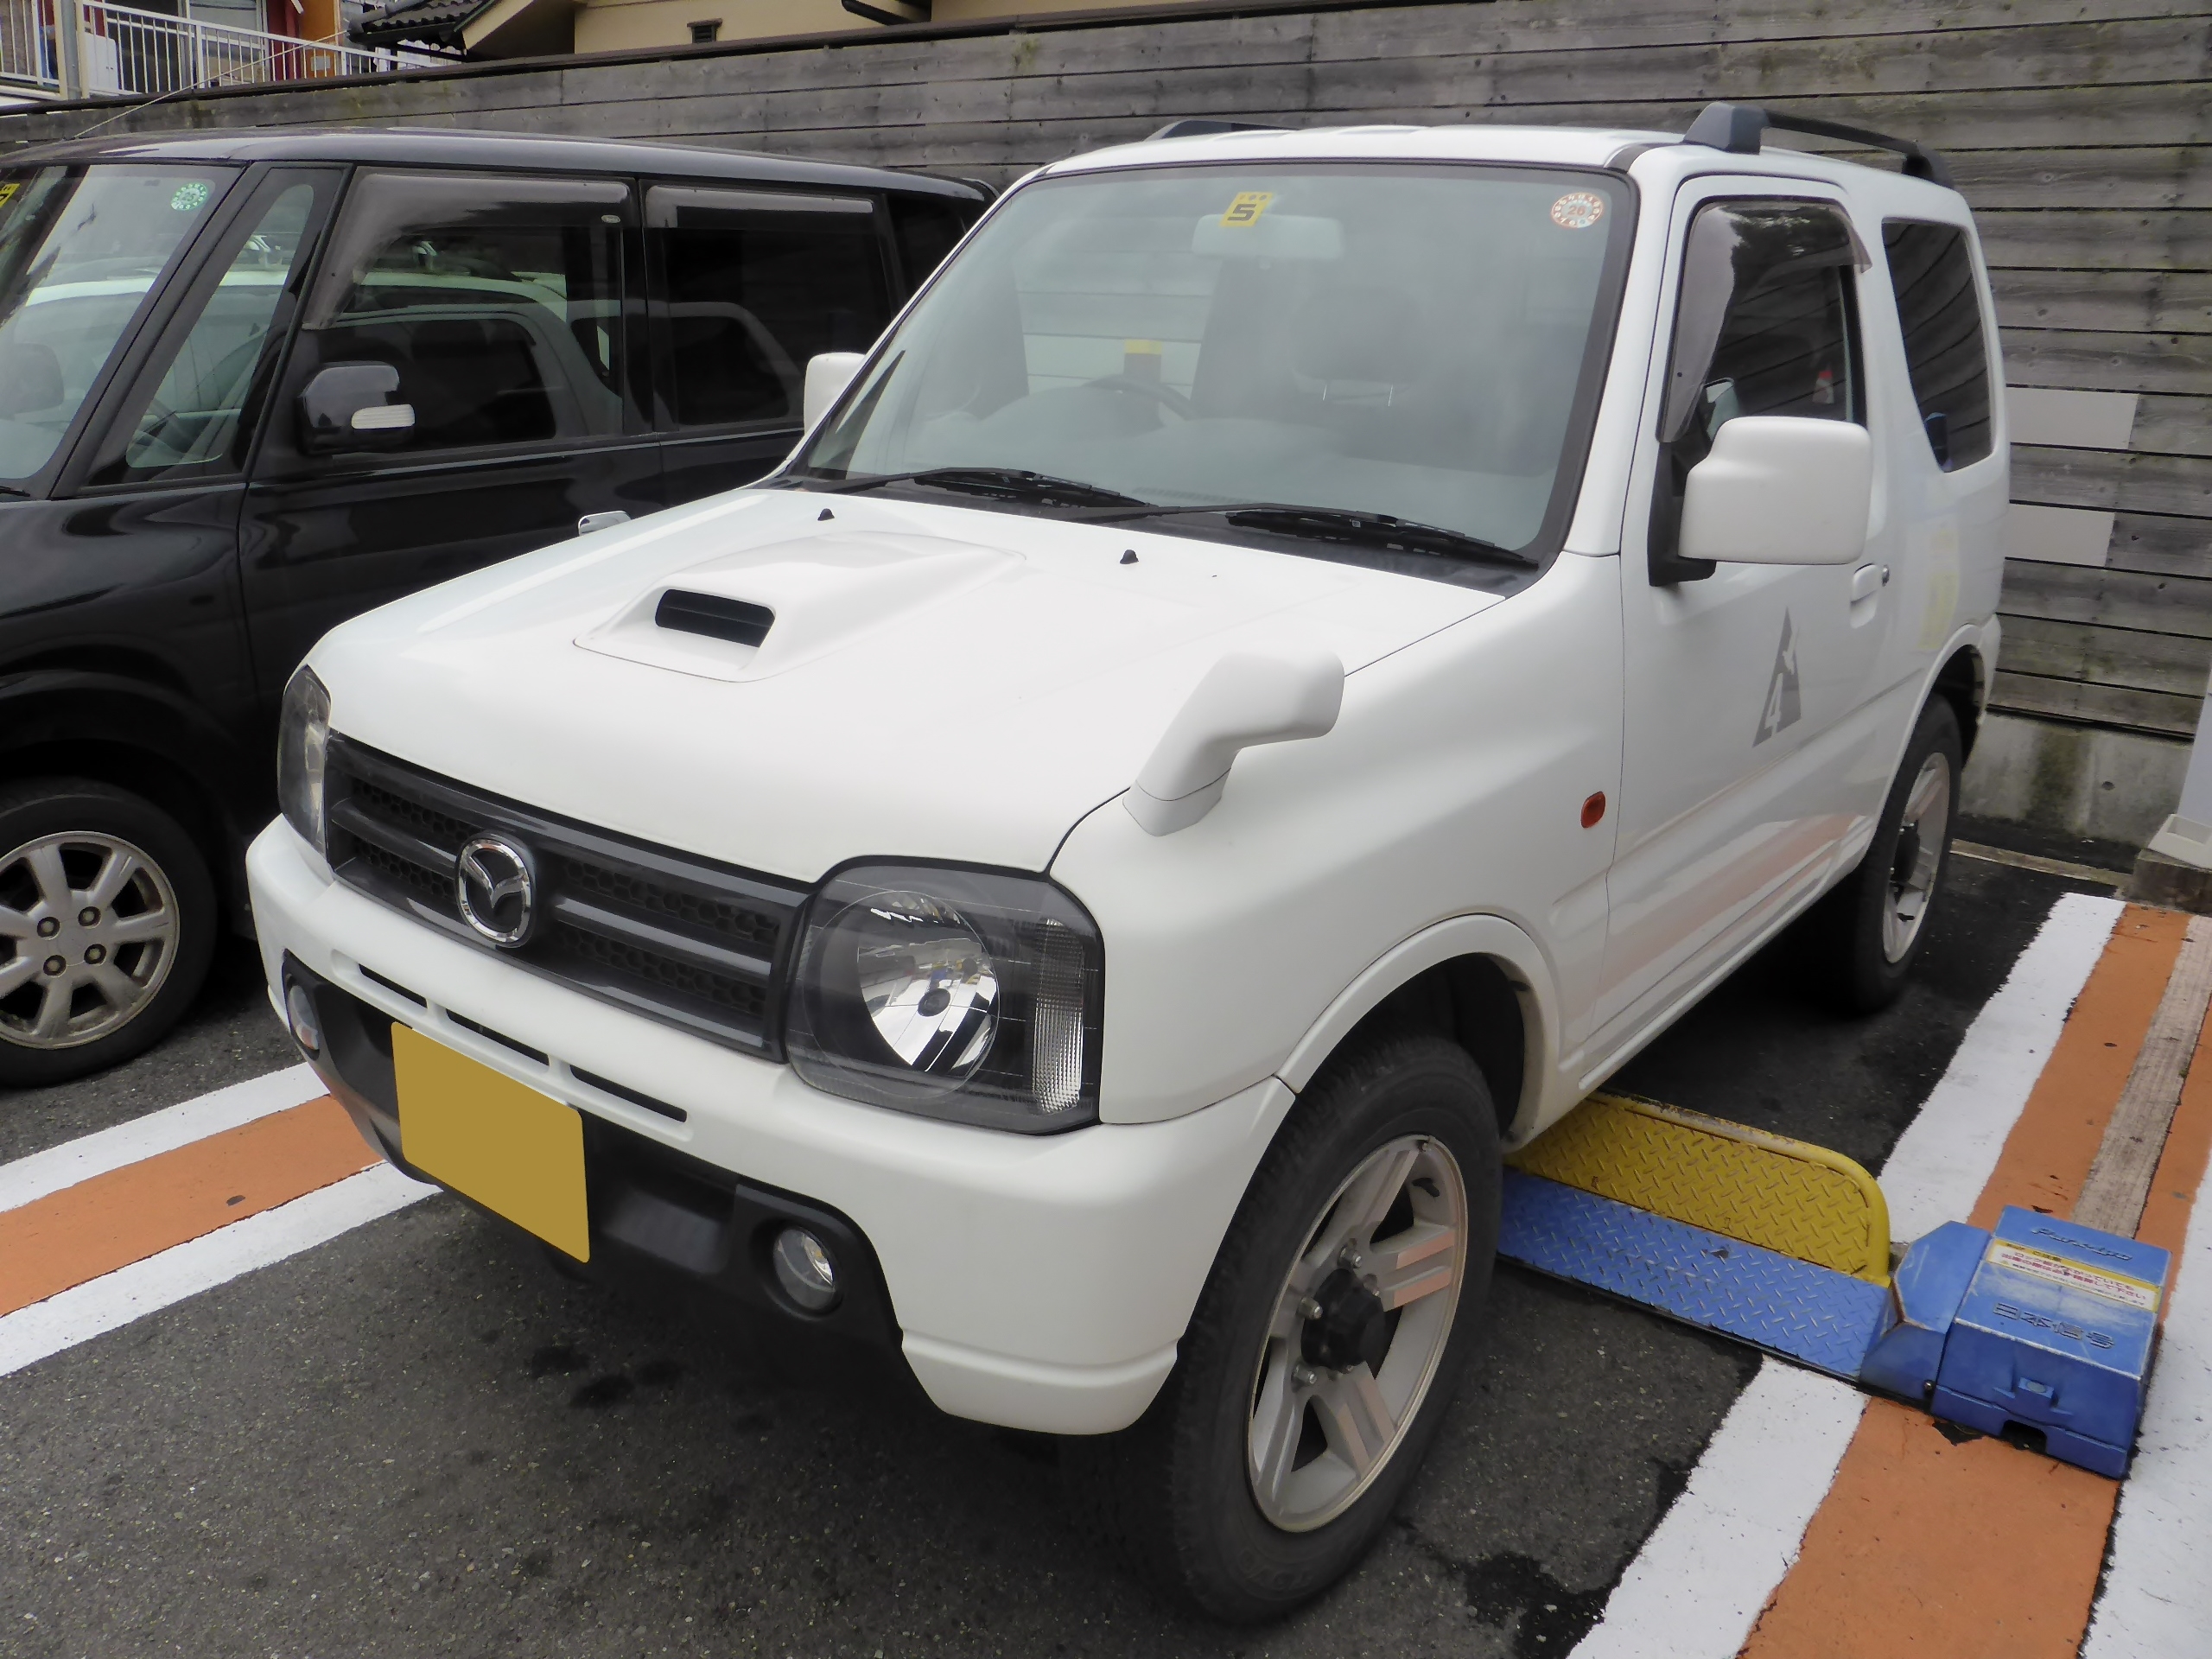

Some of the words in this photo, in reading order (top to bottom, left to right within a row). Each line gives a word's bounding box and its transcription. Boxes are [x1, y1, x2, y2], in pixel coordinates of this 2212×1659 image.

[1227, 203, 1257, 222] 5
[1992, 1301, 2116, 1350] 日本信号
